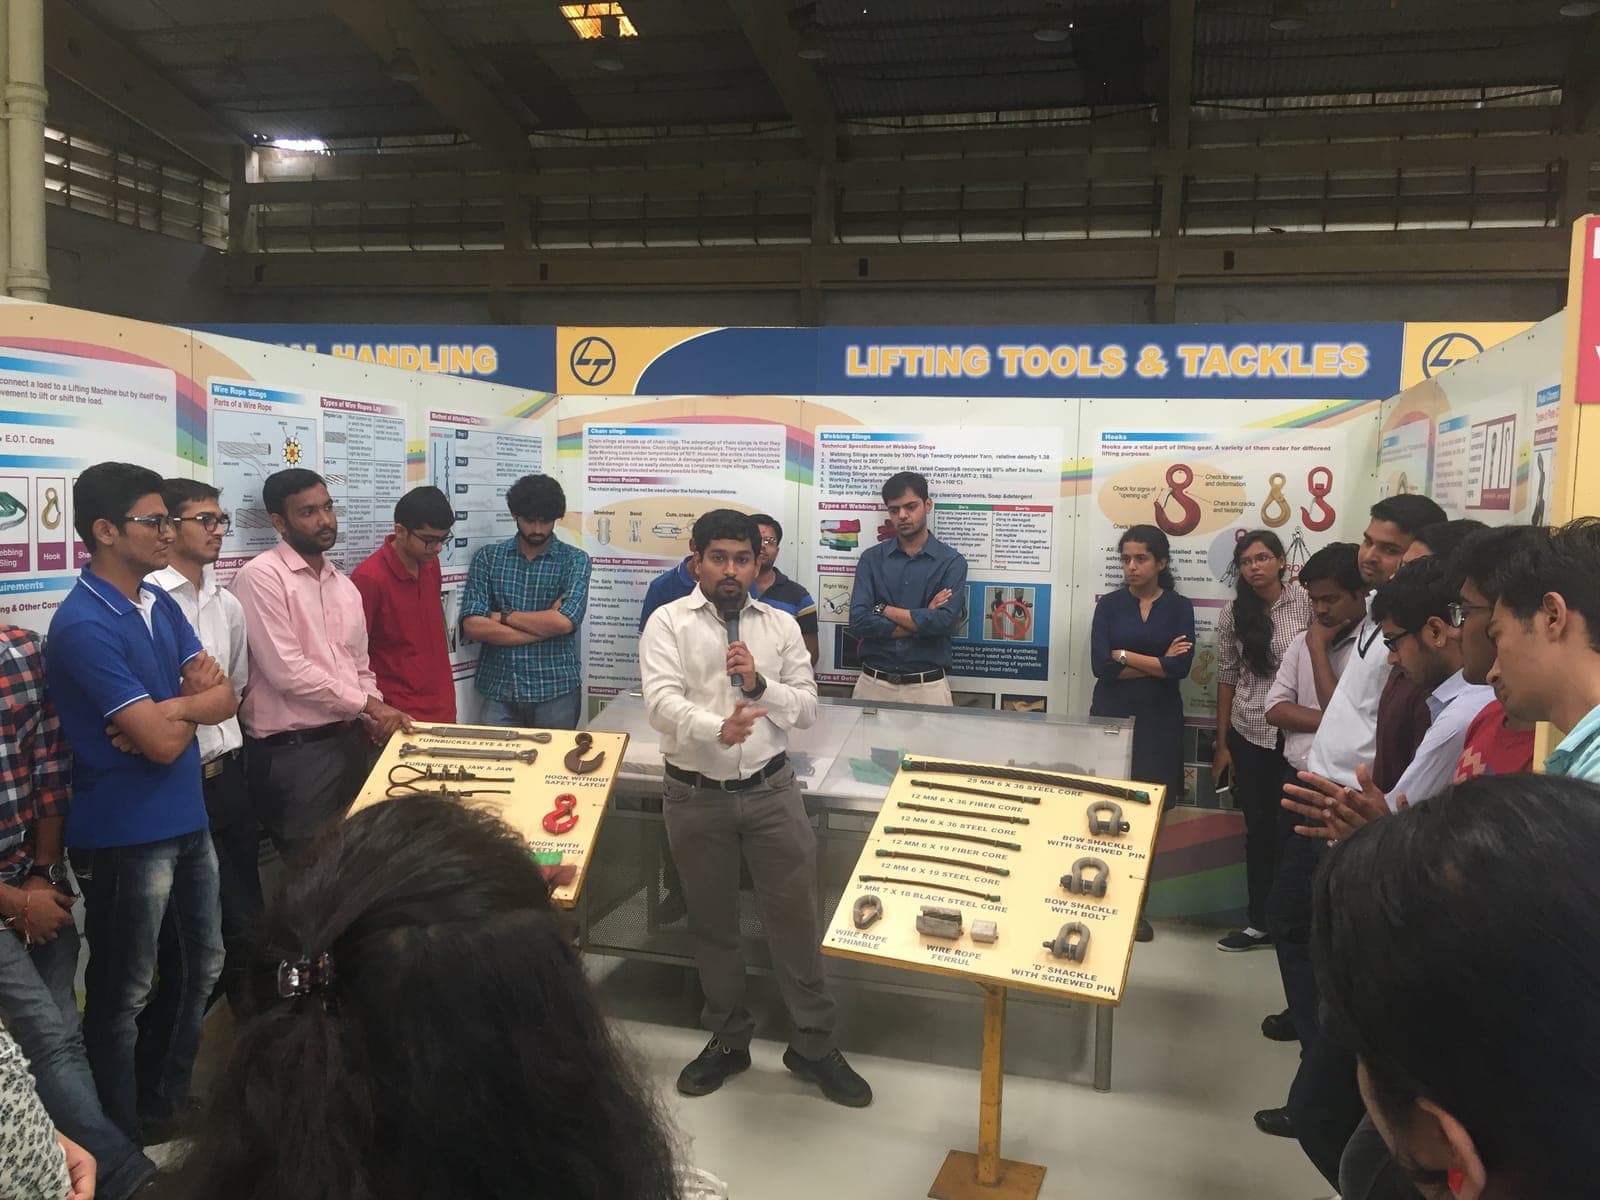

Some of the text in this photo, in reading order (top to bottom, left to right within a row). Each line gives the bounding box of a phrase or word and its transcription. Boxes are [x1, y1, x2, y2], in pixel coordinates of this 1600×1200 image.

[332, 344, 498, 374] HANDLING
[847, 345, 1369, 378] LIFTING TOOLS & TACKLES
[36, 380, 52, 390] load
[54, 382, 61, 390] to
[68, 383, 90, 395] Lifting
[91, 387, 117, 397] Machine
[118, 388, 129, 397] but
[130, 390, 138, 399] by
[213, 384, 267, 399] Wire Rope Slings
[38, 391, 48, 400] lift
[50, 393, 58, 401] or
[59, 393, 74, 402] shift
[76, 395, 86, 404] the
[88, 396, 104, 405] load.
[214, 398, 230, 407] Parts
[231, 399, 238, 408] of
[243, 400, 257, 410] Wire
[258, 401, 273, 412] Rope
[5, 434, 55, 445] E.O.T. Cranes
[1154, 444, 1168, 452] part
[1177, 444, 1196, 452] lifting
[1221, 445, 1243, 453] variety
[43, 552, 60, 561] Hook
[215, 559, 237, 568] Strand
[11, 604, 17, 612] &
[18, 603, 41, 612] Other
[571, 775, 610, 783] WITHOUT
[979, 778, 995, 786] MM
[1027, 784, 1055, 794] STEEL
[1057, 788, 1084, 797] CORE
[969, 800, 995, 810] FIBER
[997, 804, 1024, 813] CORE
[912, 816, 928, 824] MM
[959, 822, 988, 833] STEEL
[991, 827, 1017, 837] CORE
[528, 840, 554, 848] HOOK
[904, 840, 920, 848] MM
[929, 843, 938, 851] X
[939, 844, 950, 852] 19
[951, 846, 979, 857] FIBER
[981, 851, 1008, 861] CORE
[1047, 839, 1146, 860] WITH SCREWED PIN
[1062, 835, 1134, 851] BOW SHACKLE
[893, 864, 909, 872] MM
[929, 869, 940, 877] 19
[942, 871, 971, 882] STEEL
[974, 876, 1001, 887] CORE
[864, 885, 880, 893] MM
[889, 888, 898, 896] X
[900, 890, 911, 898] 18
[912, 891, 945, 903] BLACK
[947, 898, 978, 909] STEEL
[980, 903, 1008, 914] CORE
[1044, 897, 1118, 915] BOW SHACKLE
[1051, 906, 1108, 921] WITH BOLT
[835, 928, 888, 944] WIRE ROPE
[837, 937, 880, 951] THIMBLE
[926, 943, 982, 960] WIRE ROPE
[931, 954, 971, 967] FERRUL
[1011, 968, 1116, 994] WITH SCREWED PIN
[1047, 966, 1098, 982] SHACKLE
